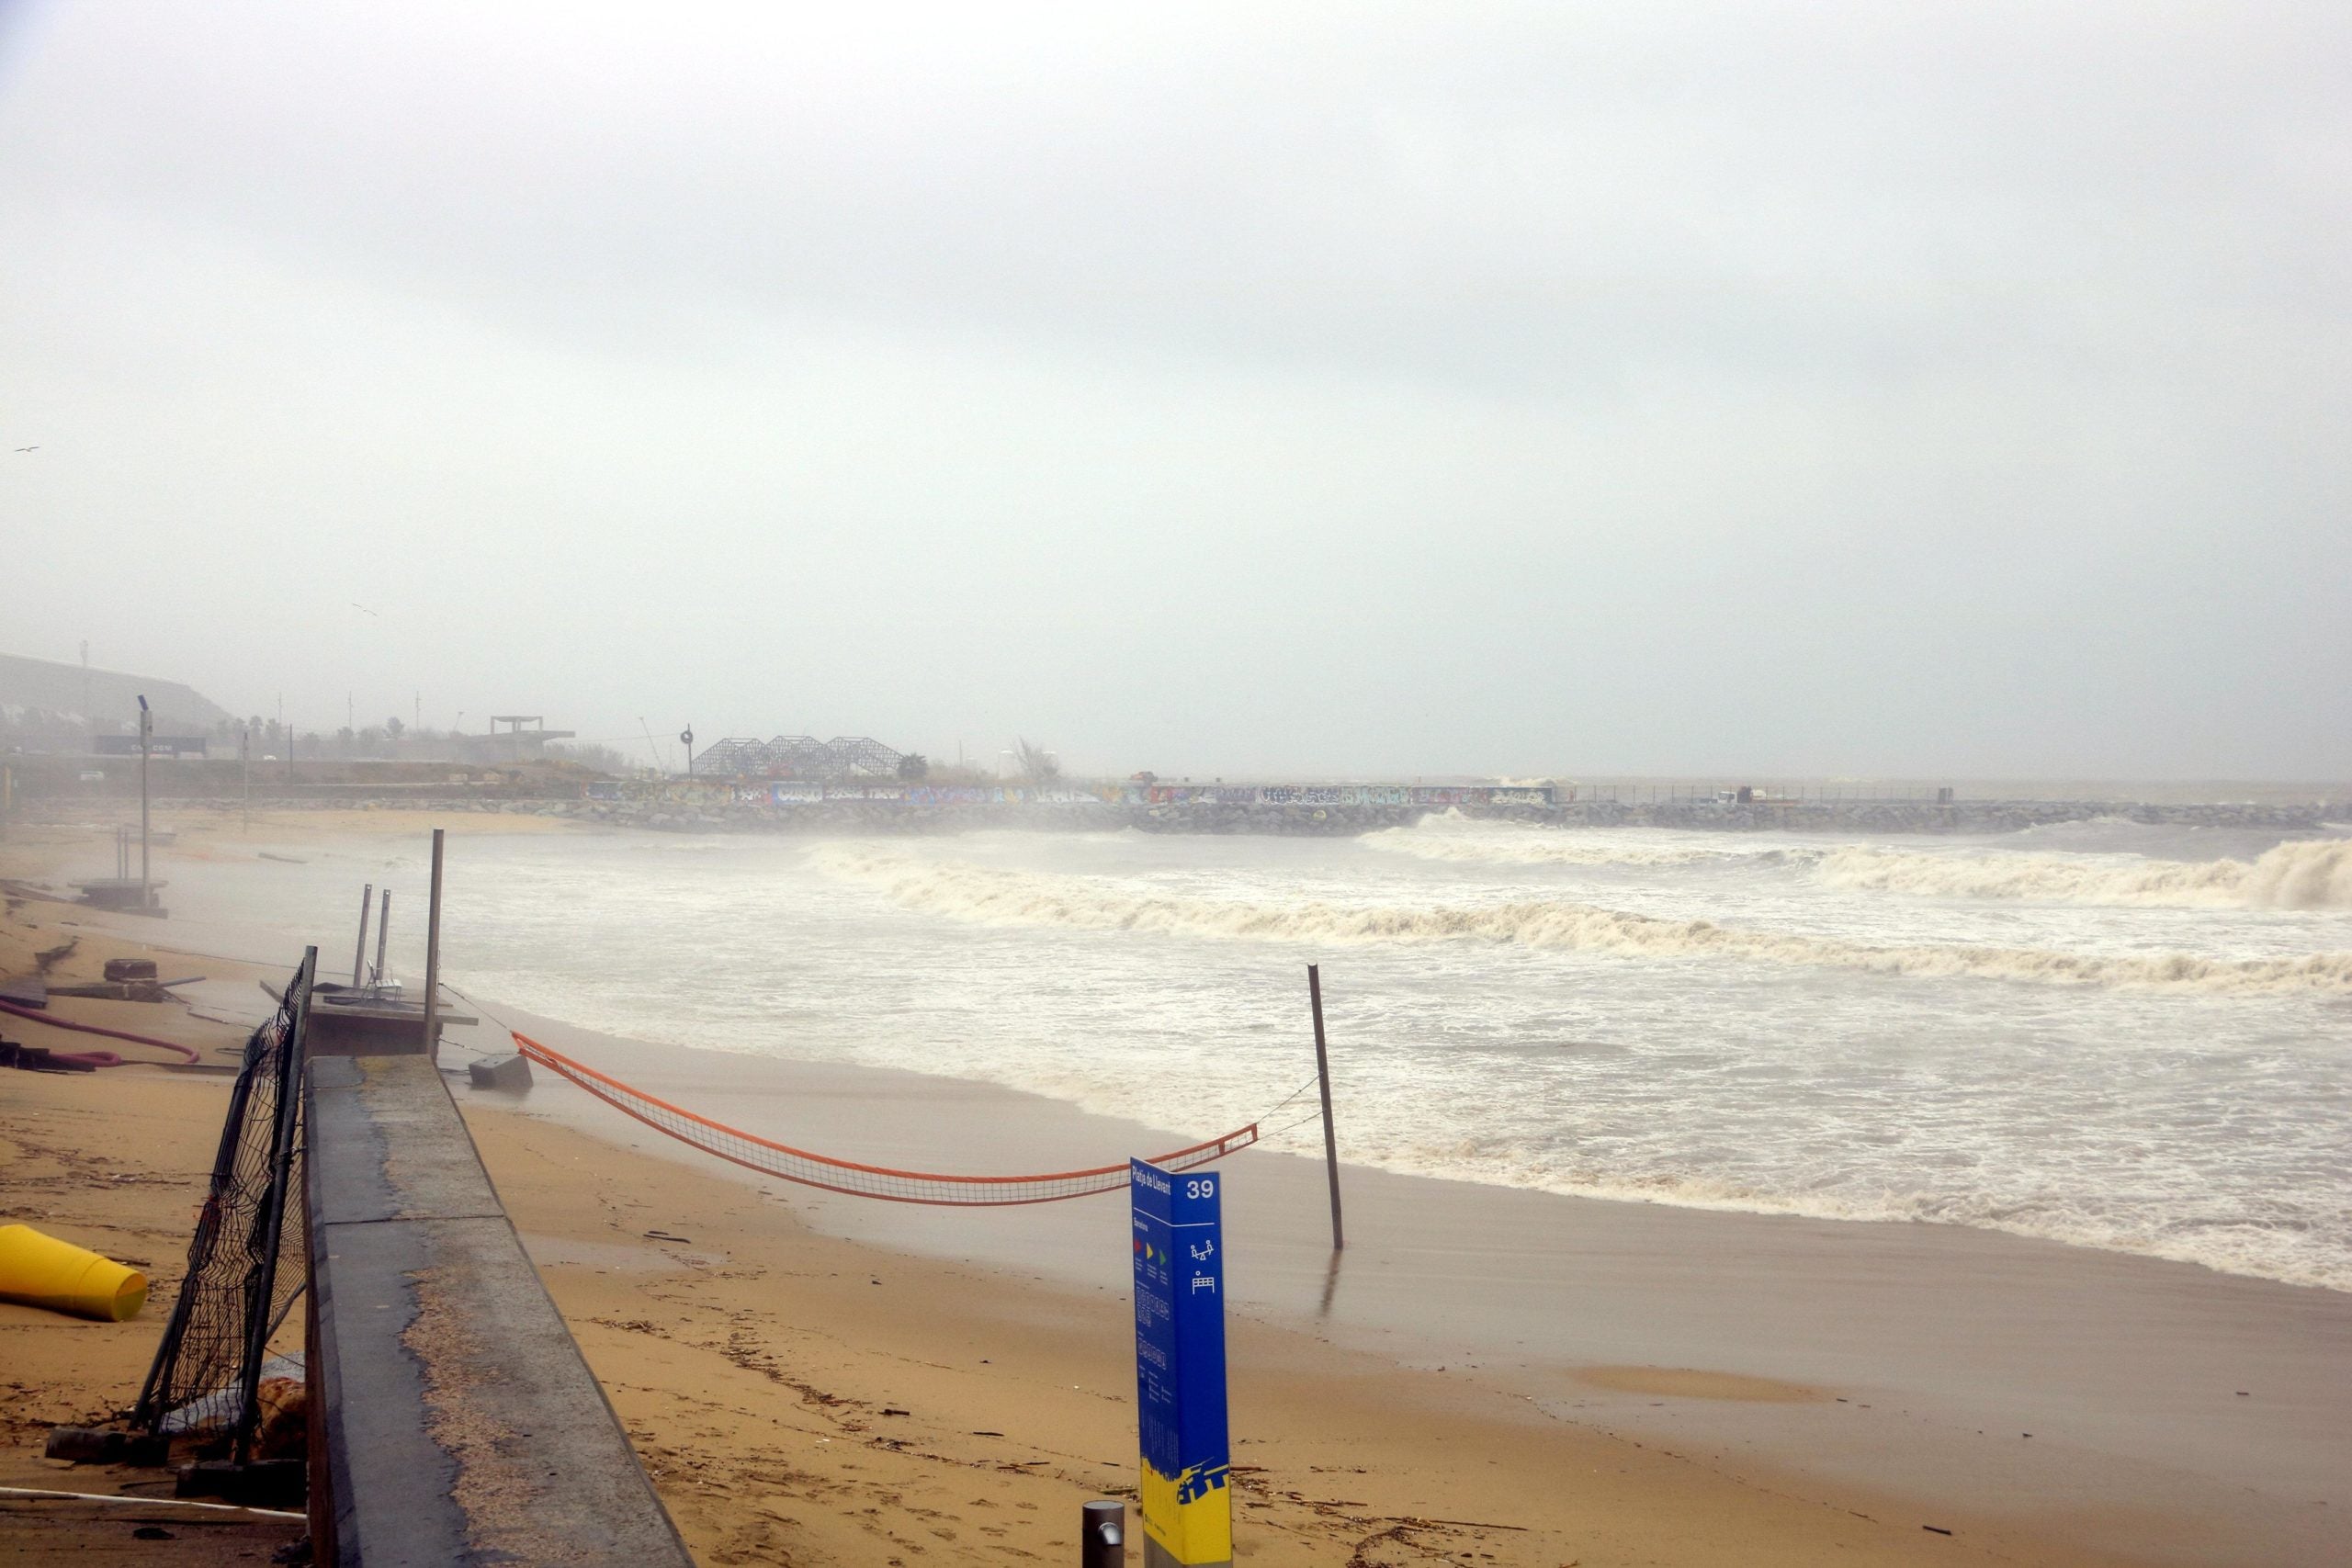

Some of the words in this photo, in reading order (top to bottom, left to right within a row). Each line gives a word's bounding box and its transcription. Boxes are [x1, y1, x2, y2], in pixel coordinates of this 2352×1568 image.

[1132, 1166, 1146, 1187] Platja
[1147, 1172, 1153, 1188] de
[1153, 1174, 1171, 1195] Llevant
[1187, 1180, 1214, 1199] 39
